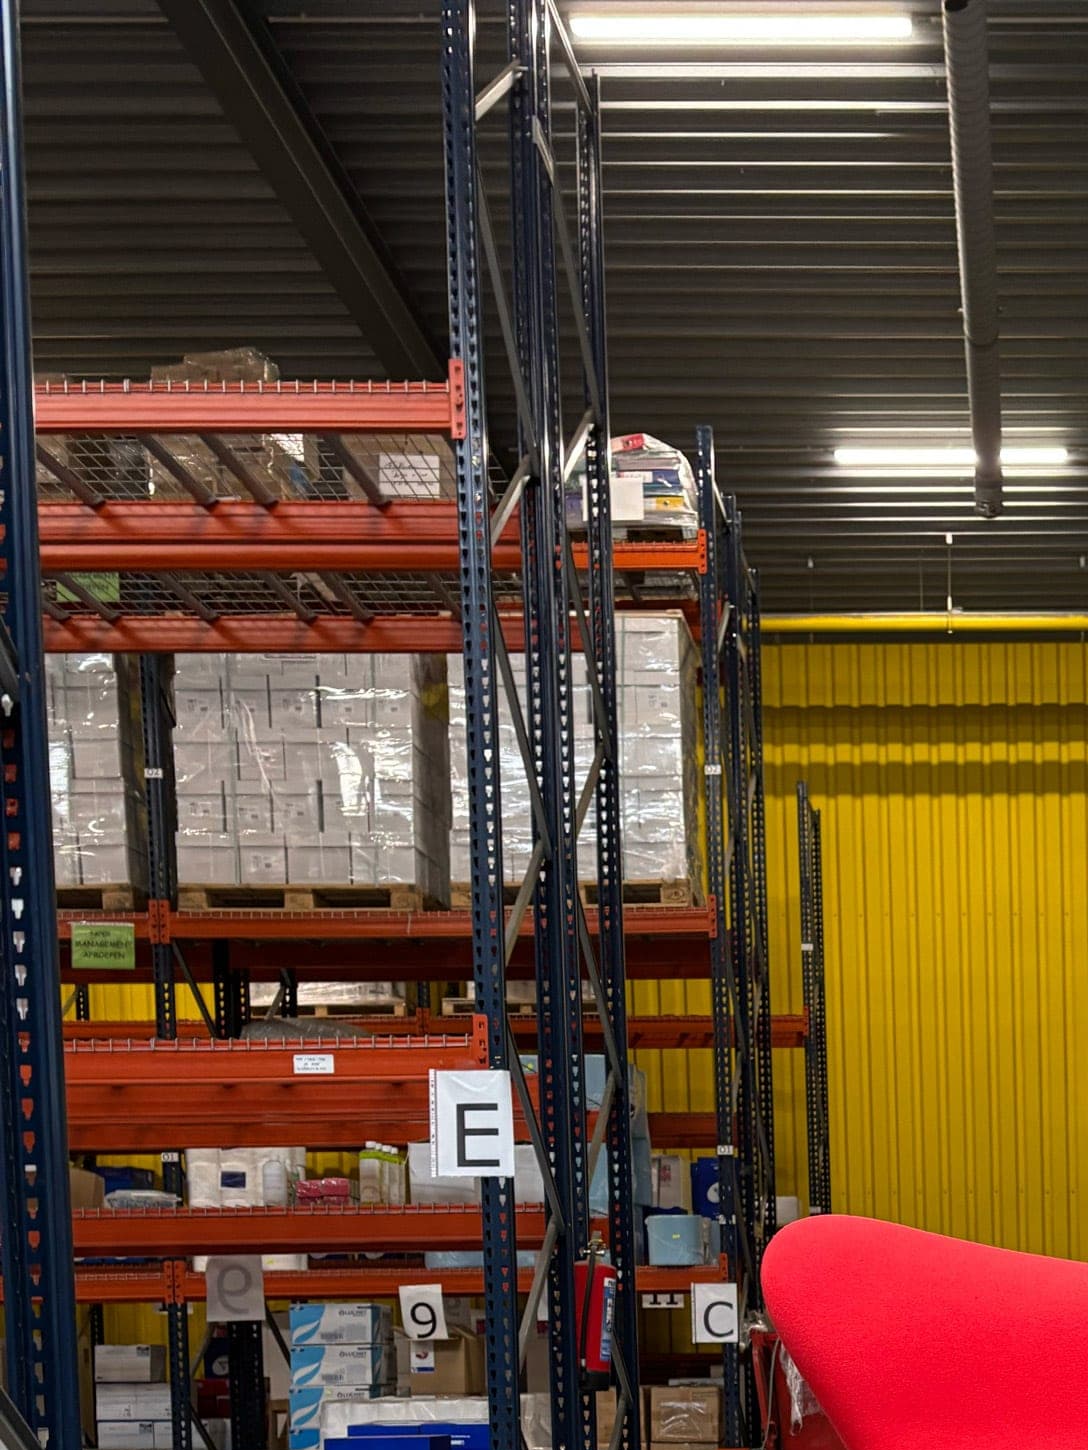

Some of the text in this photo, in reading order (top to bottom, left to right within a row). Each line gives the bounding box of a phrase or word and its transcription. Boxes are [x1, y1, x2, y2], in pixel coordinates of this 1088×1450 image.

[456, 1103, 500, 1168] E
[410, 1302, 437, 1338] 9
[703, 1301, 734, 1338] C
